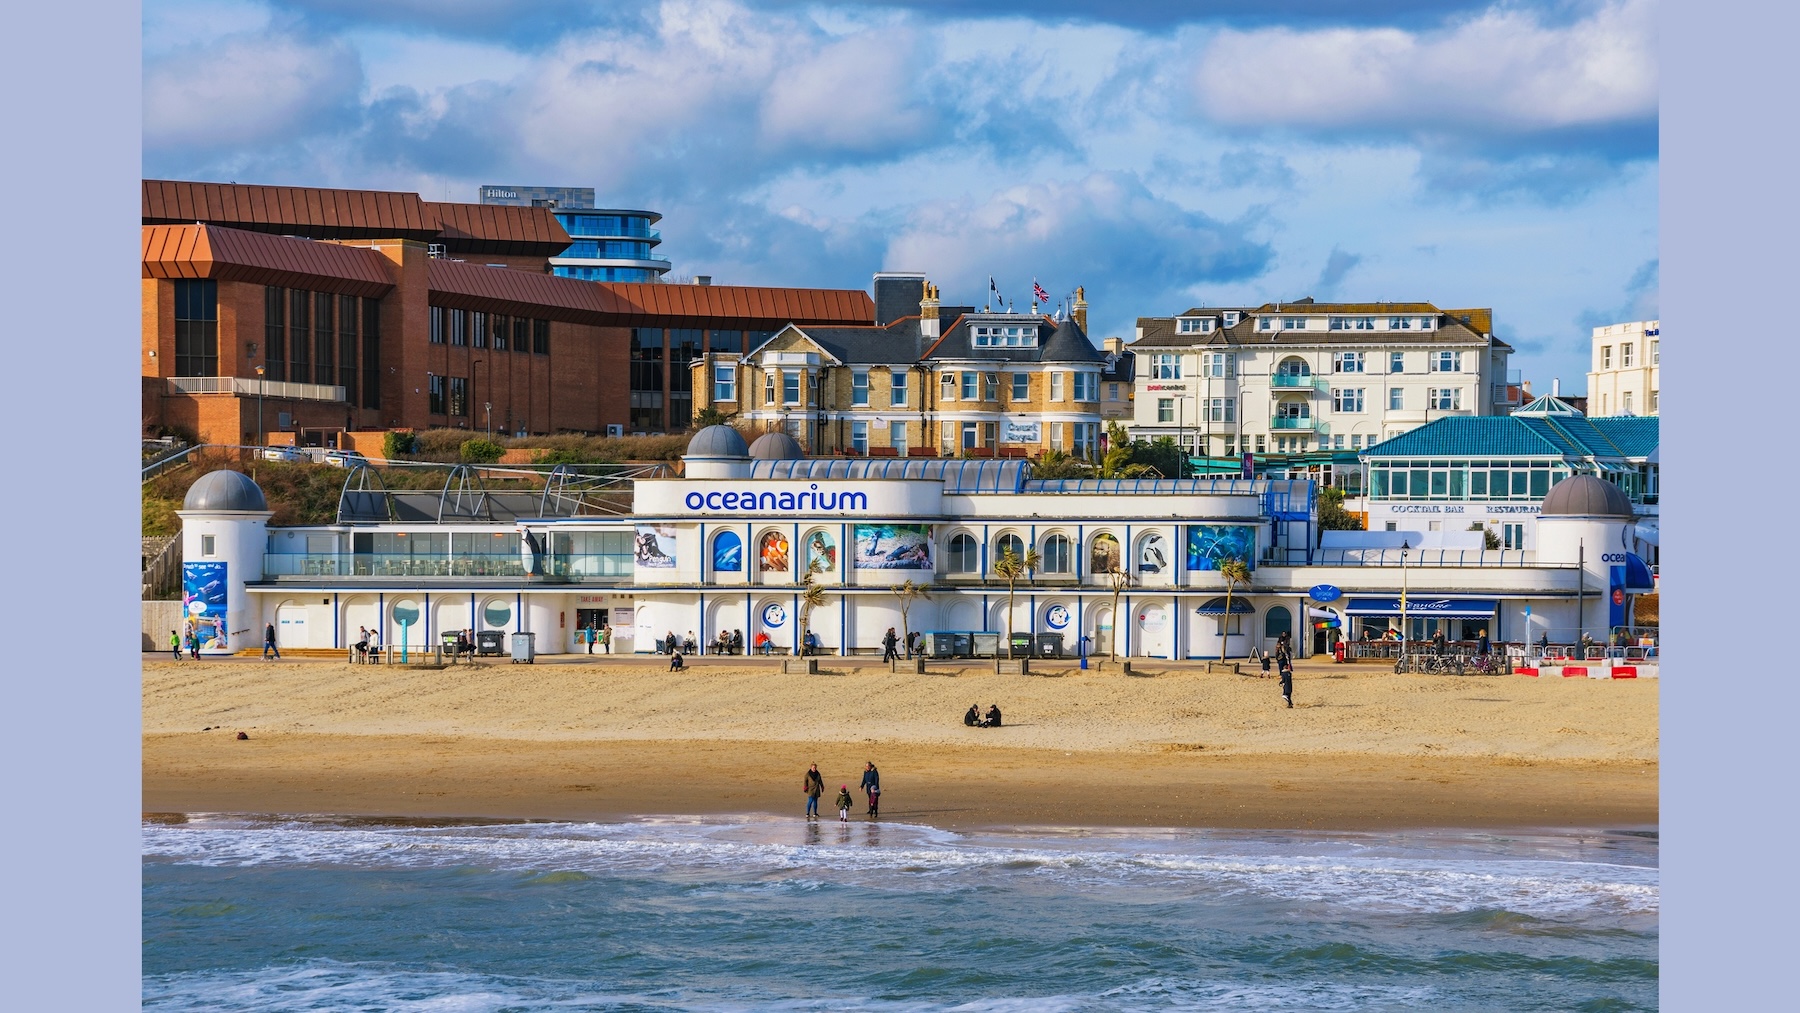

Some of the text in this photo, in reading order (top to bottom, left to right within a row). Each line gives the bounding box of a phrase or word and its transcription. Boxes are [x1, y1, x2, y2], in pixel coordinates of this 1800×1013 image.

[487, 189, 517, 198] Hilton
[1007, 422, 1038, 431] Court
[1005, 432, 1037, 443] Royal
[685, 483, 867, 510] oceanarium
[1391, 505, 1441, 513] COCKTAIL
[1444, 505, 1465, 513] BAR
[649, 555, 672, 563] Penguin
